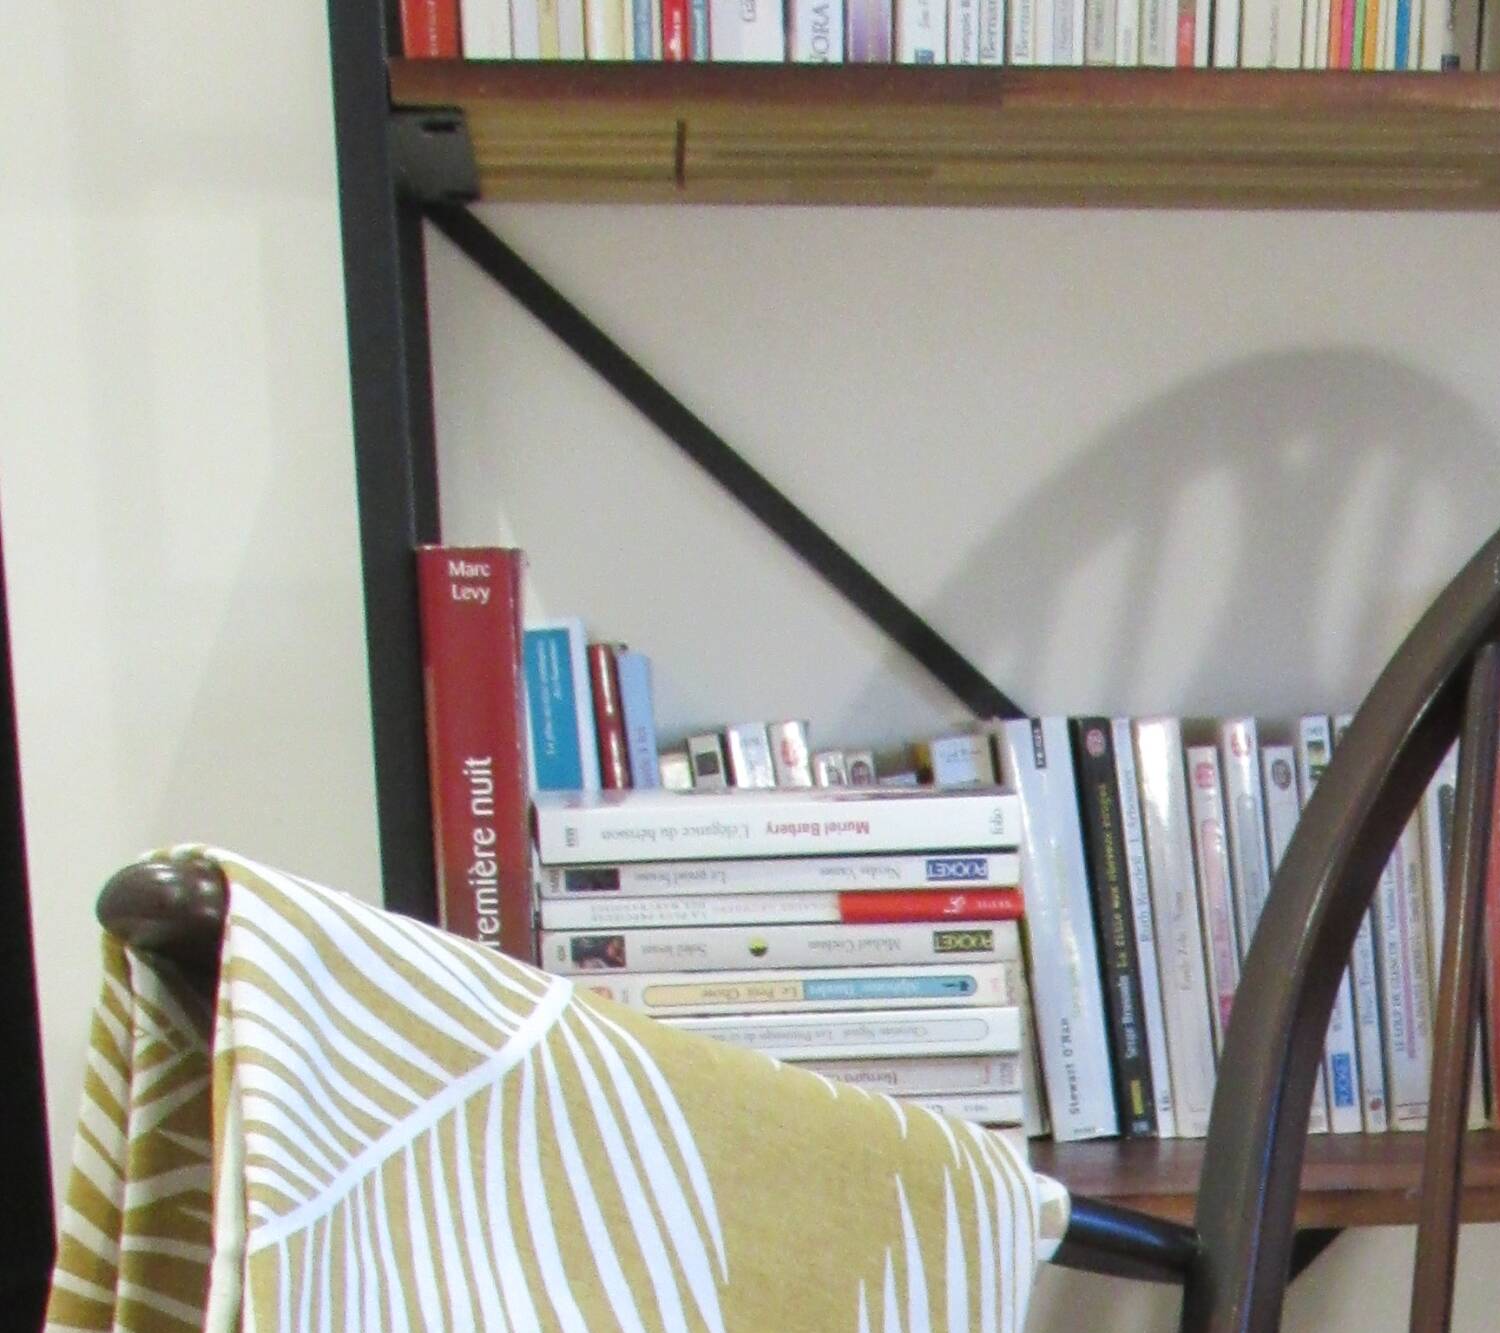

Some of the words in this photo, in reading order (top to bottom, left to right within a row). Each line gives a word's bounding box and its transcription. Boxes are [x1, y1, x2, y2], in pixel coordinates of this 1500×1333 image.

[448, 560, 491, 577] Marc
[451, 584, 491, 604] Levy
[463, 756, 492, 816] nuit
[660, 826, 674, 841] du
[766, 820, 821, 837] Barbery
[825, 820, 870, 835] Muriel
[927, 859, 988, 880] POCKET
[467, 827, 501, 950] remière
[935, 932, 994, 951] POCKET
[784, 985, 799, 998] Le
[1065, 1063, 1081, 1115] Stewart
